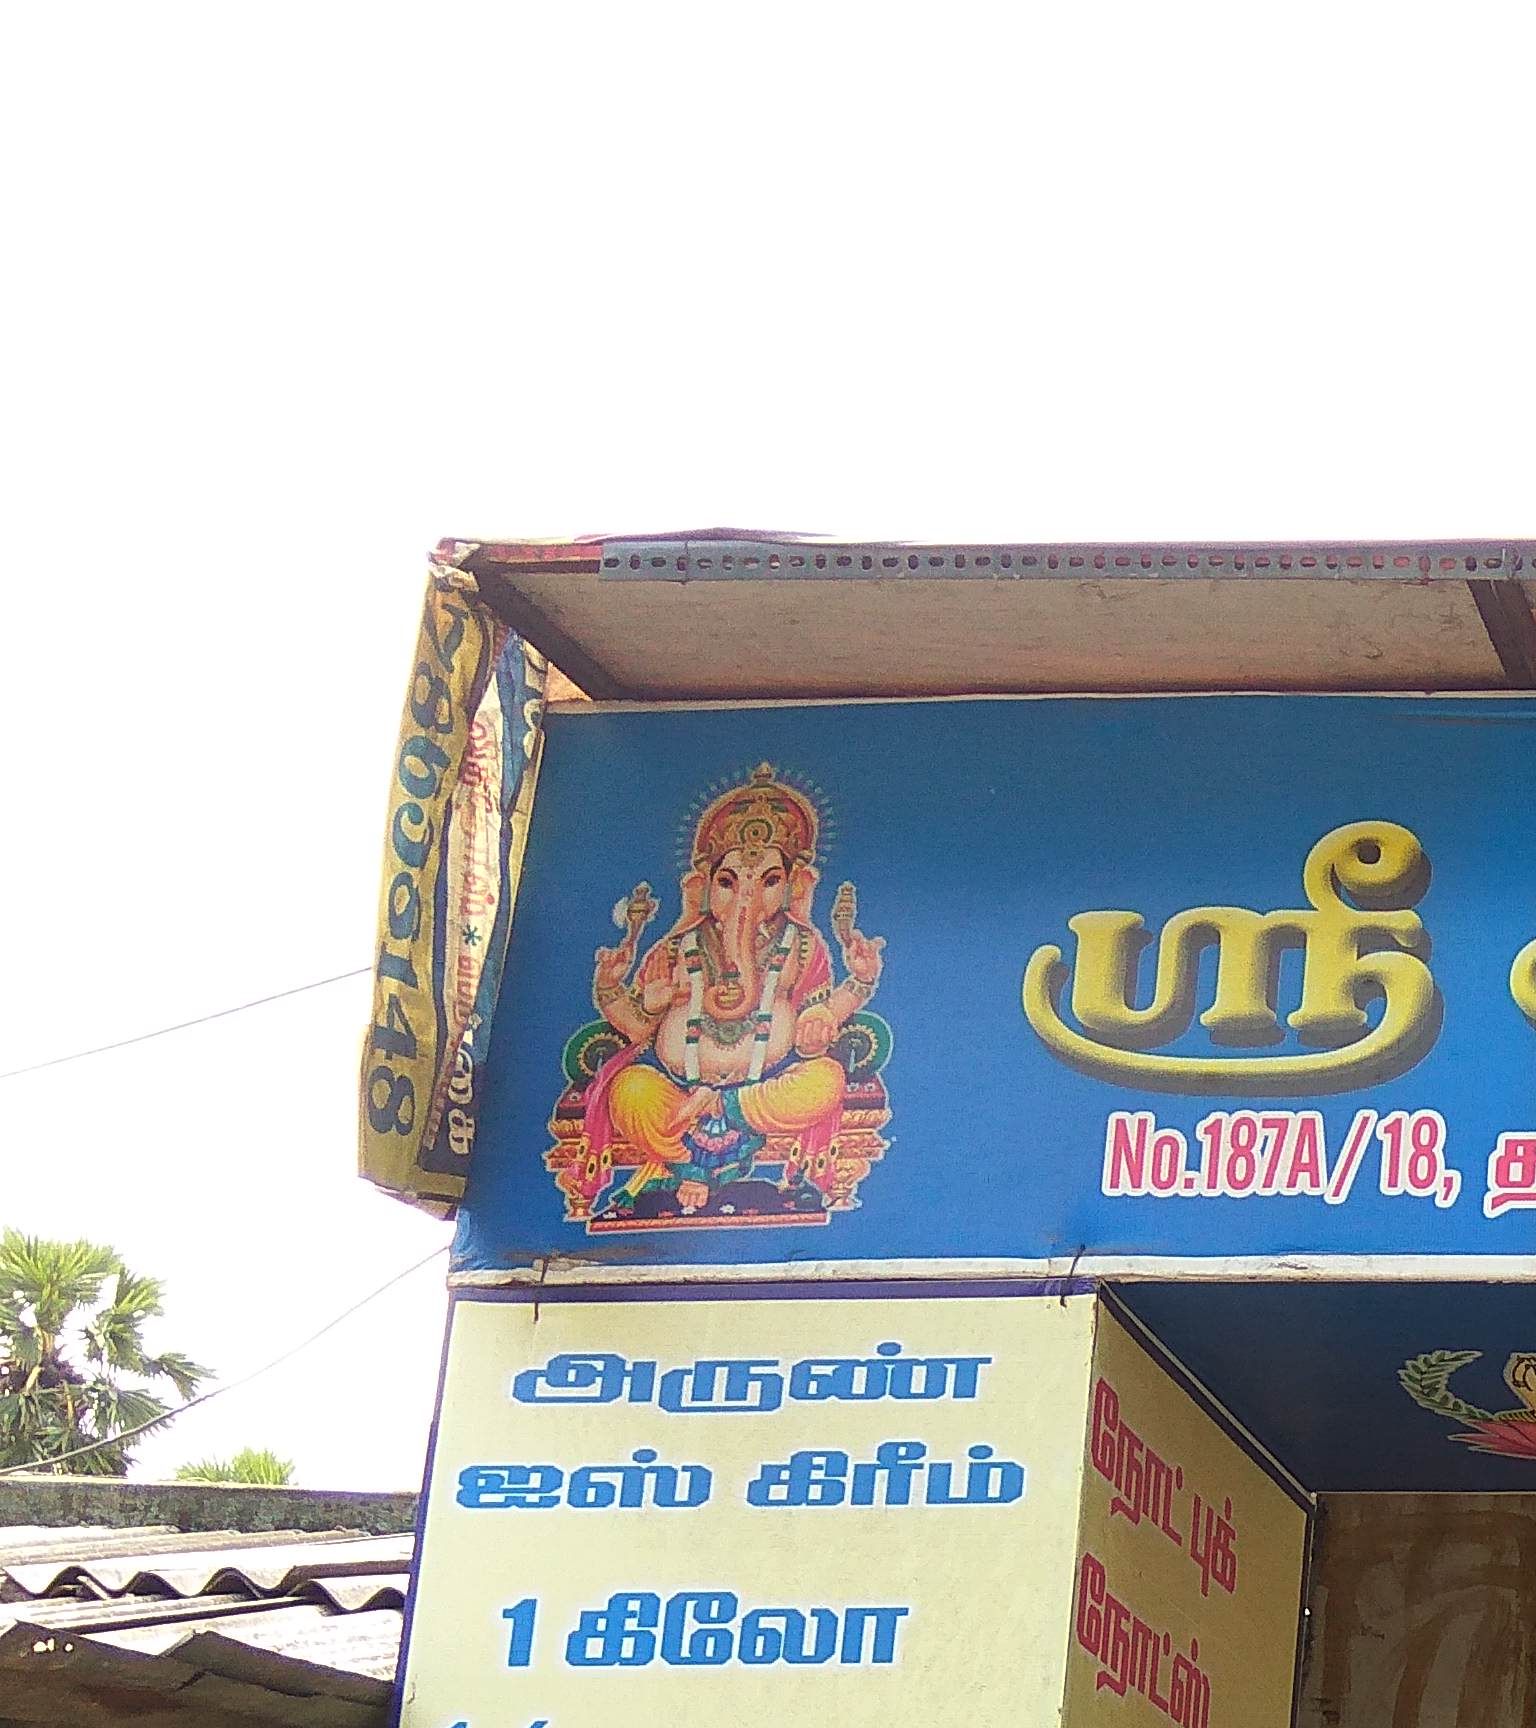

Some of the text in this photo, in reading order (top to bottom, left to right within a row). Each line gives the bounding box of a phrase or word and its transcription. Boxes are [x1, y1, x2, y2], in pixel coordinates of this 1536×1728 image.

[512, 1341, 992, 1413] அருண்
[456, 1440, 1026, 1509] ஐஸ் கிரீம்
[1091, 1375, 1238, 1598] நோட் புக்
[501, 1591, 910, 1667] 1 கிலோ
